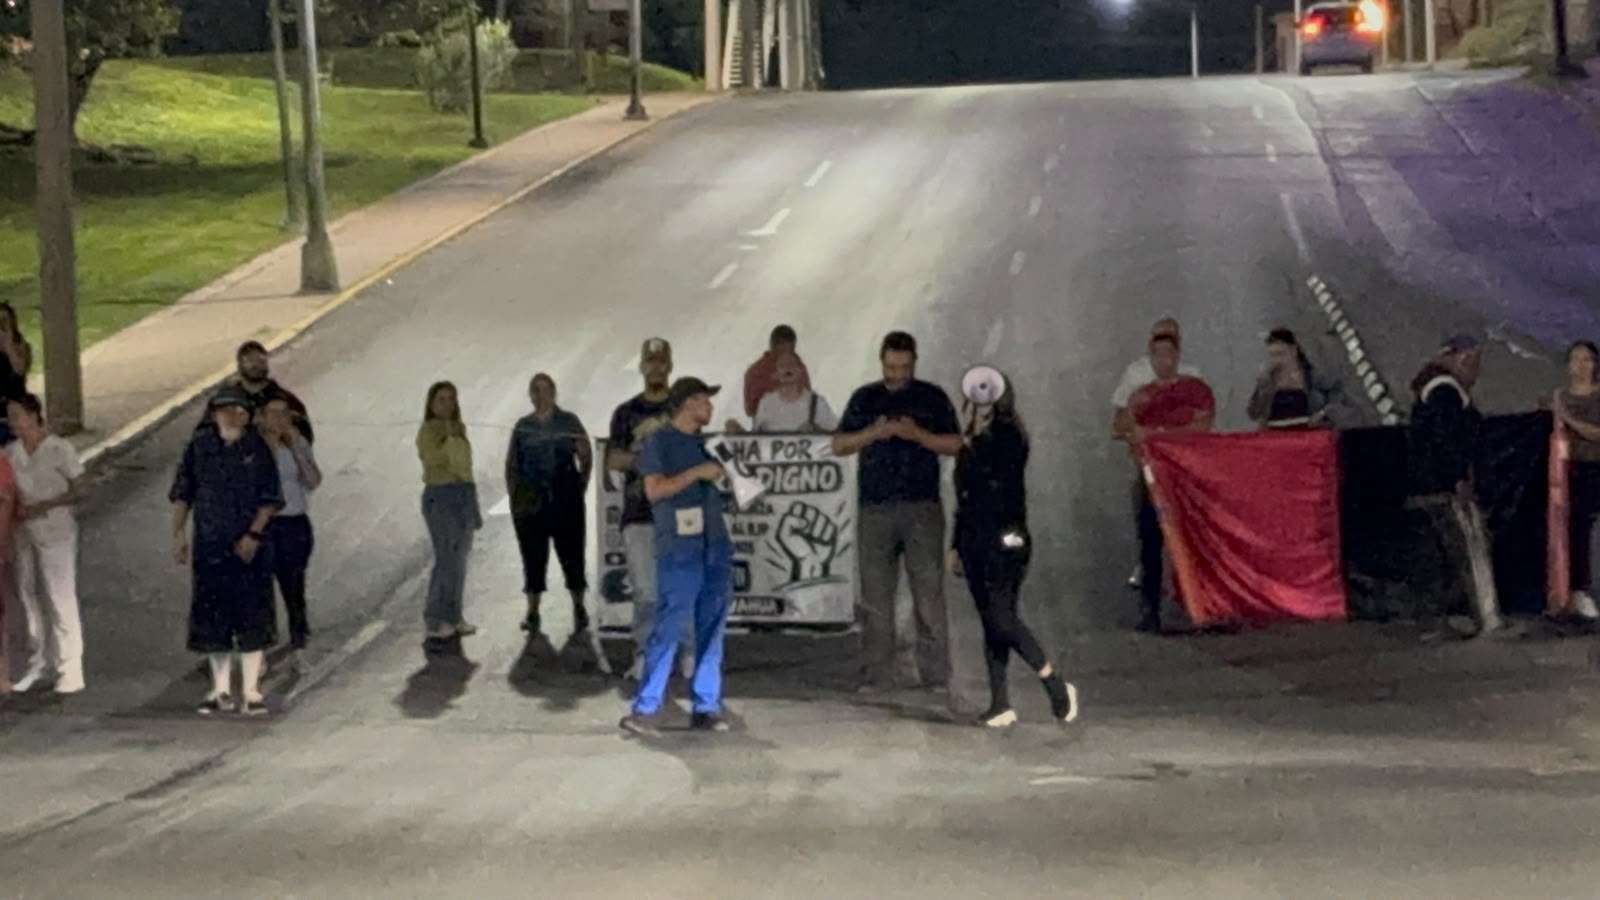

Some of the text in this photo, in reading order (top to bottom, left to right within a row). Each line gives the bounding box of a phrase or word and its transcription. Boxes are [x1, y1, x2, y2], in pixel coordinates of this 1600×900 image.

[734, 438, 812, 462] HA POR
[756, 464, 837, 494] DIGNO
